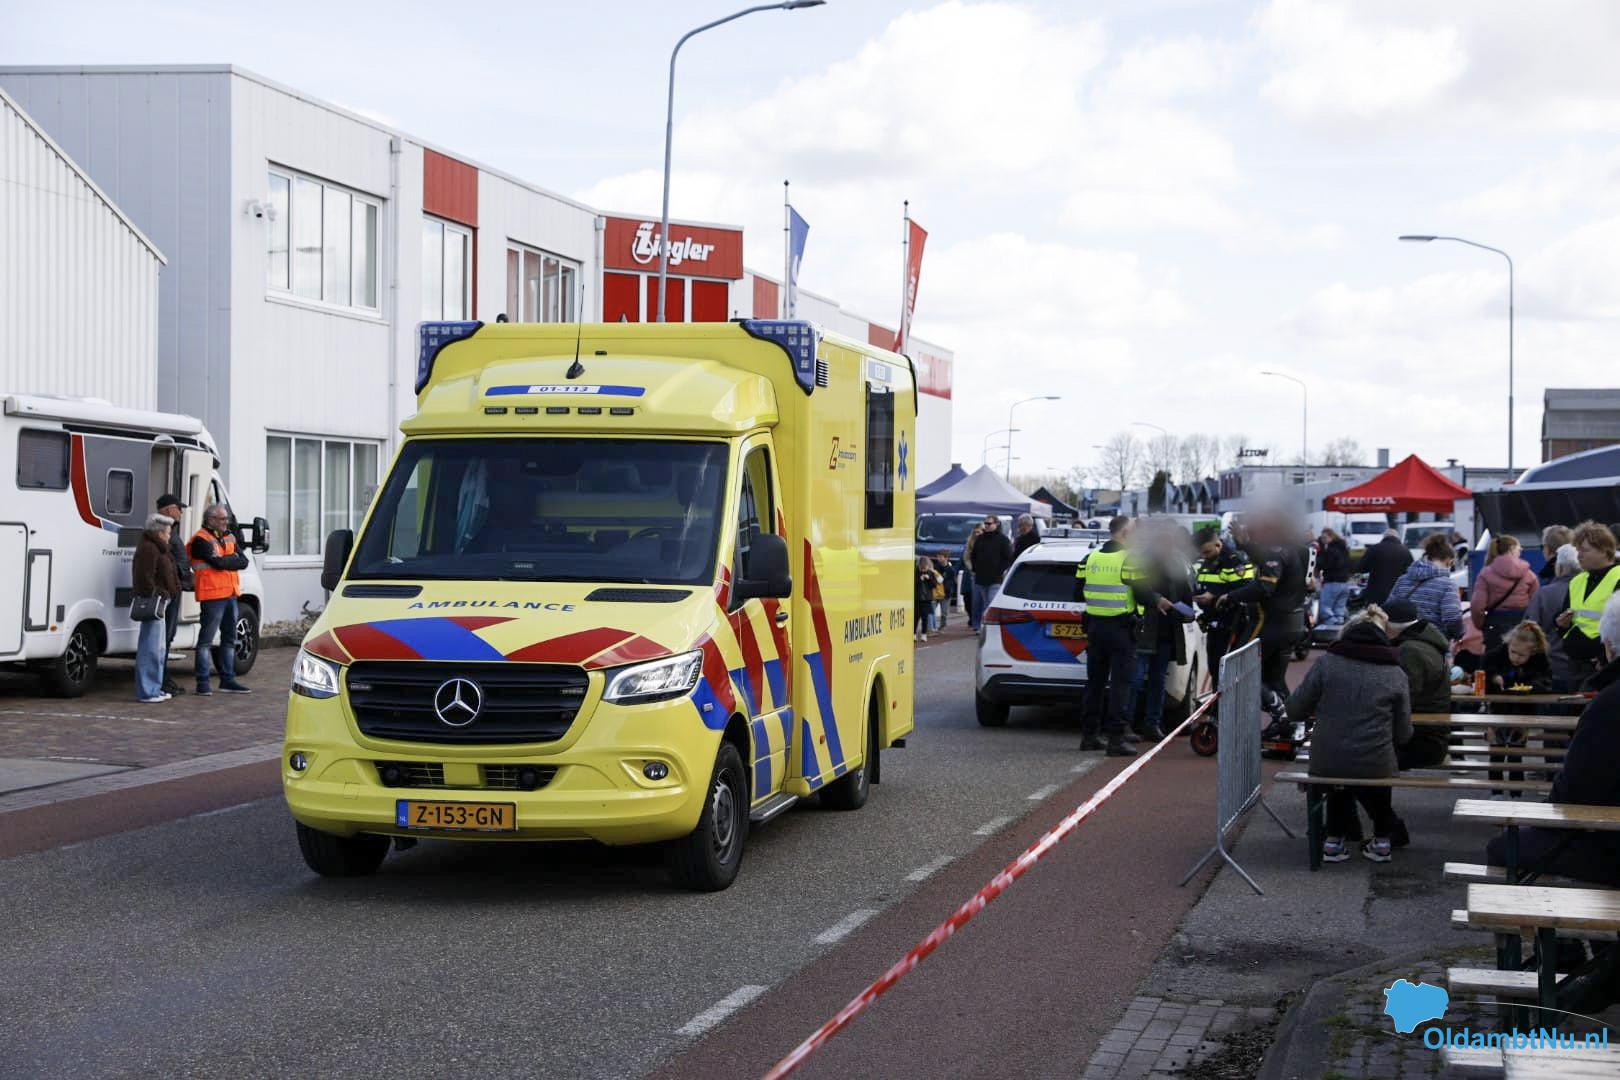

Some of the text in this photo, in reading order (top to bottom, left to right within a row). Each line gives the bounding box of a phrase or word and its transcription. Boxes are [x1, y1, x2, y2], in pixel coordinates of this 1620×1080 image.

[540, 385, 589, 394] 01-113
[1334, 496, 1396, 505] HONDA
[407, 600, 577, 612] AMBULANCE
[1023, 602, 1068, 610] POLITIE
[844, 607, 905, 644] AMBULANCE 01-113
[416, 806, 503, 825] Z-153-GN
